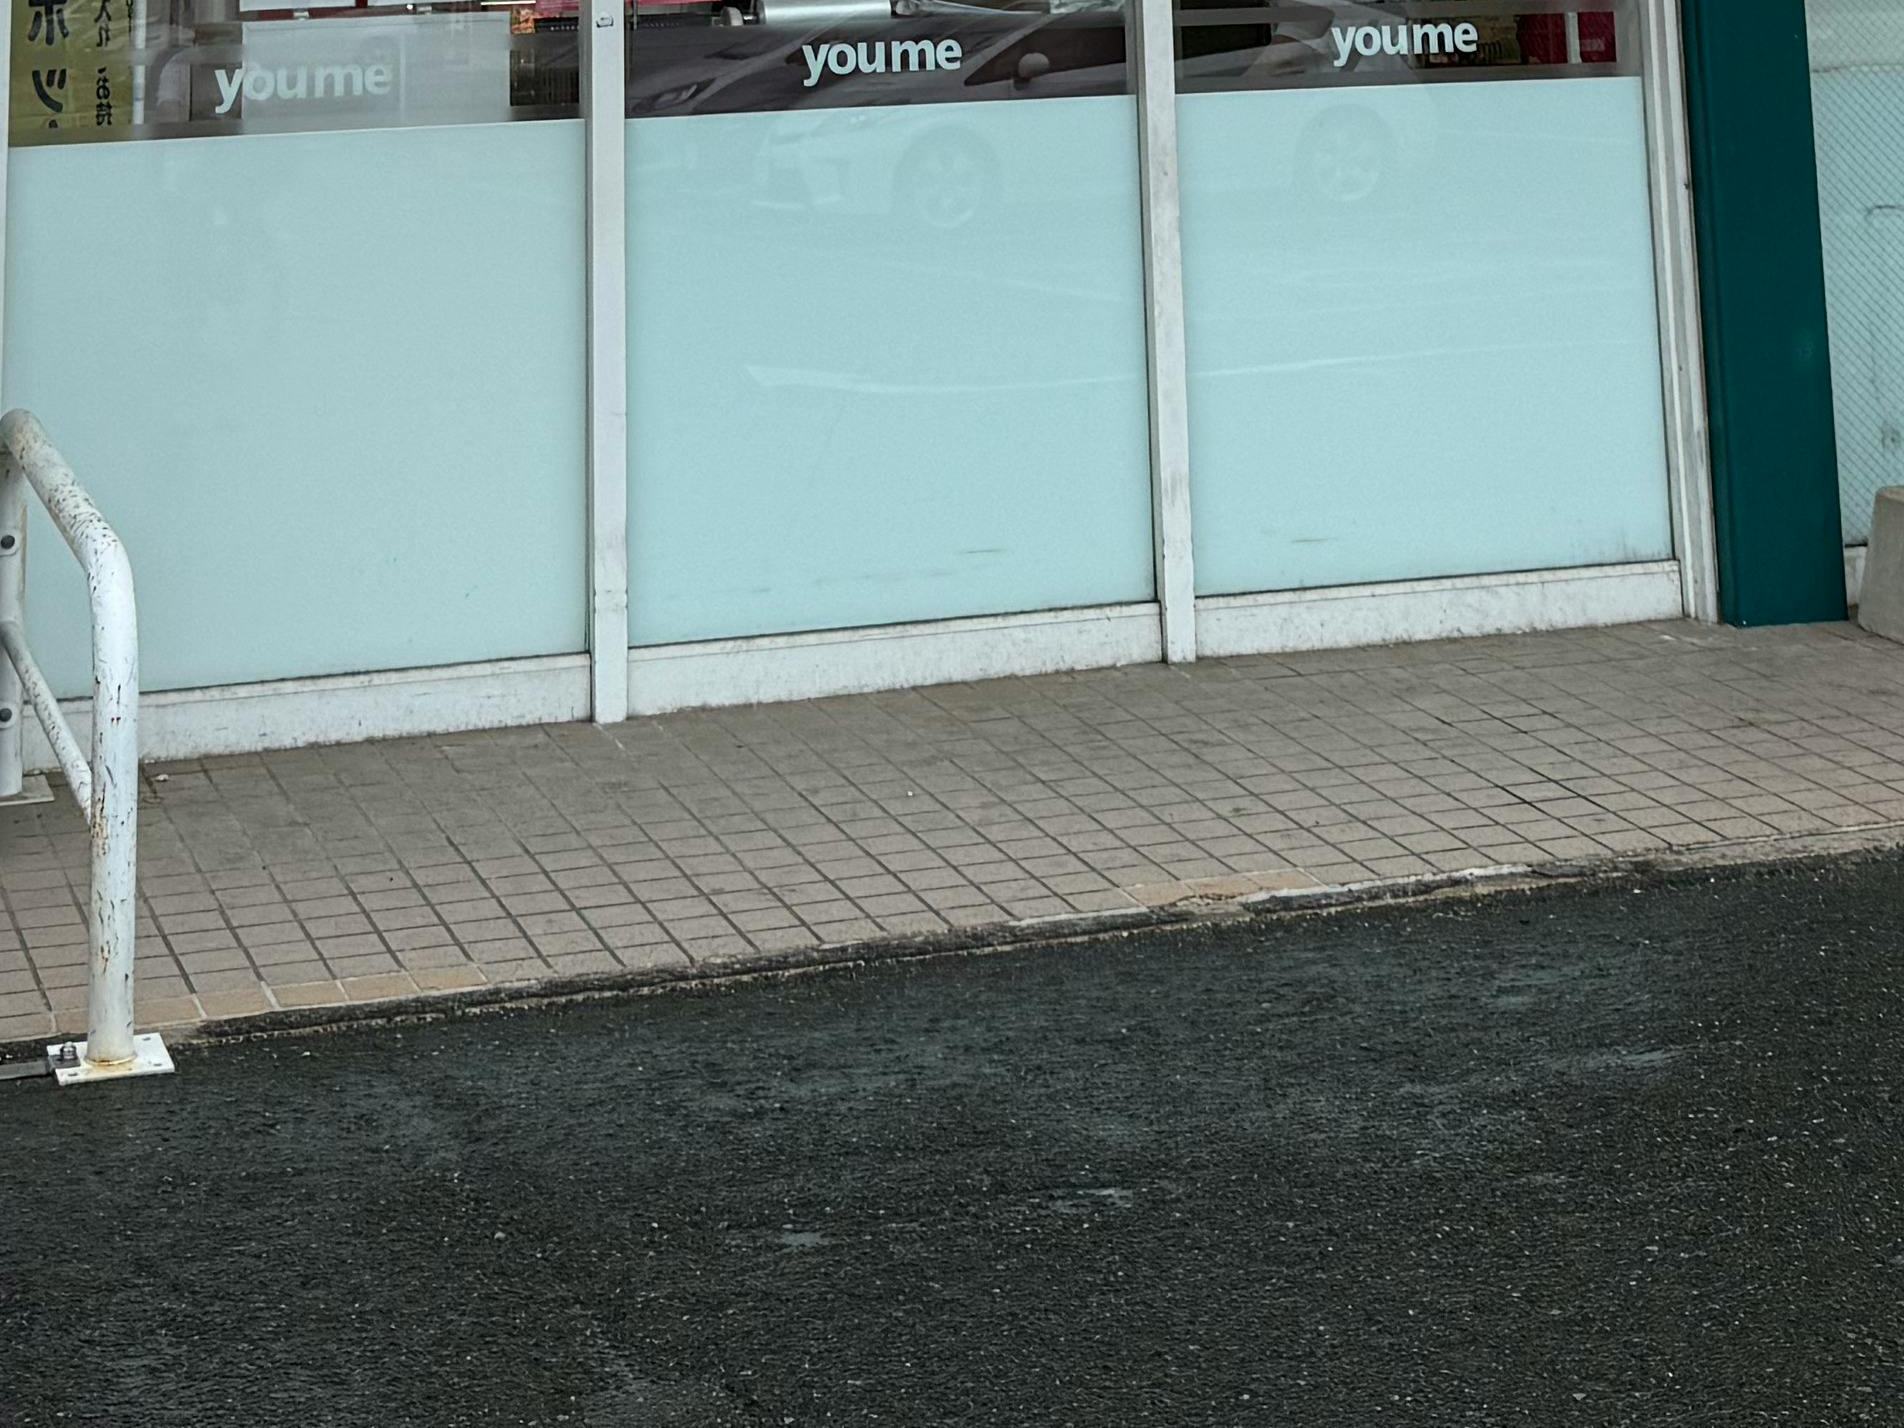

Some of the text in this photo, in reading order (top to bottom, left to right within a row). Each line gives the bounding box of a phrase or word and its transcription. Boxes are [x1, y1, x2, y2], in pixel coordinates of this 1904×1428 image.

[801, 36, 963, 87] youme
[1331, 20, 1480, 67] youme
[214, 63, 393, 114] youme
